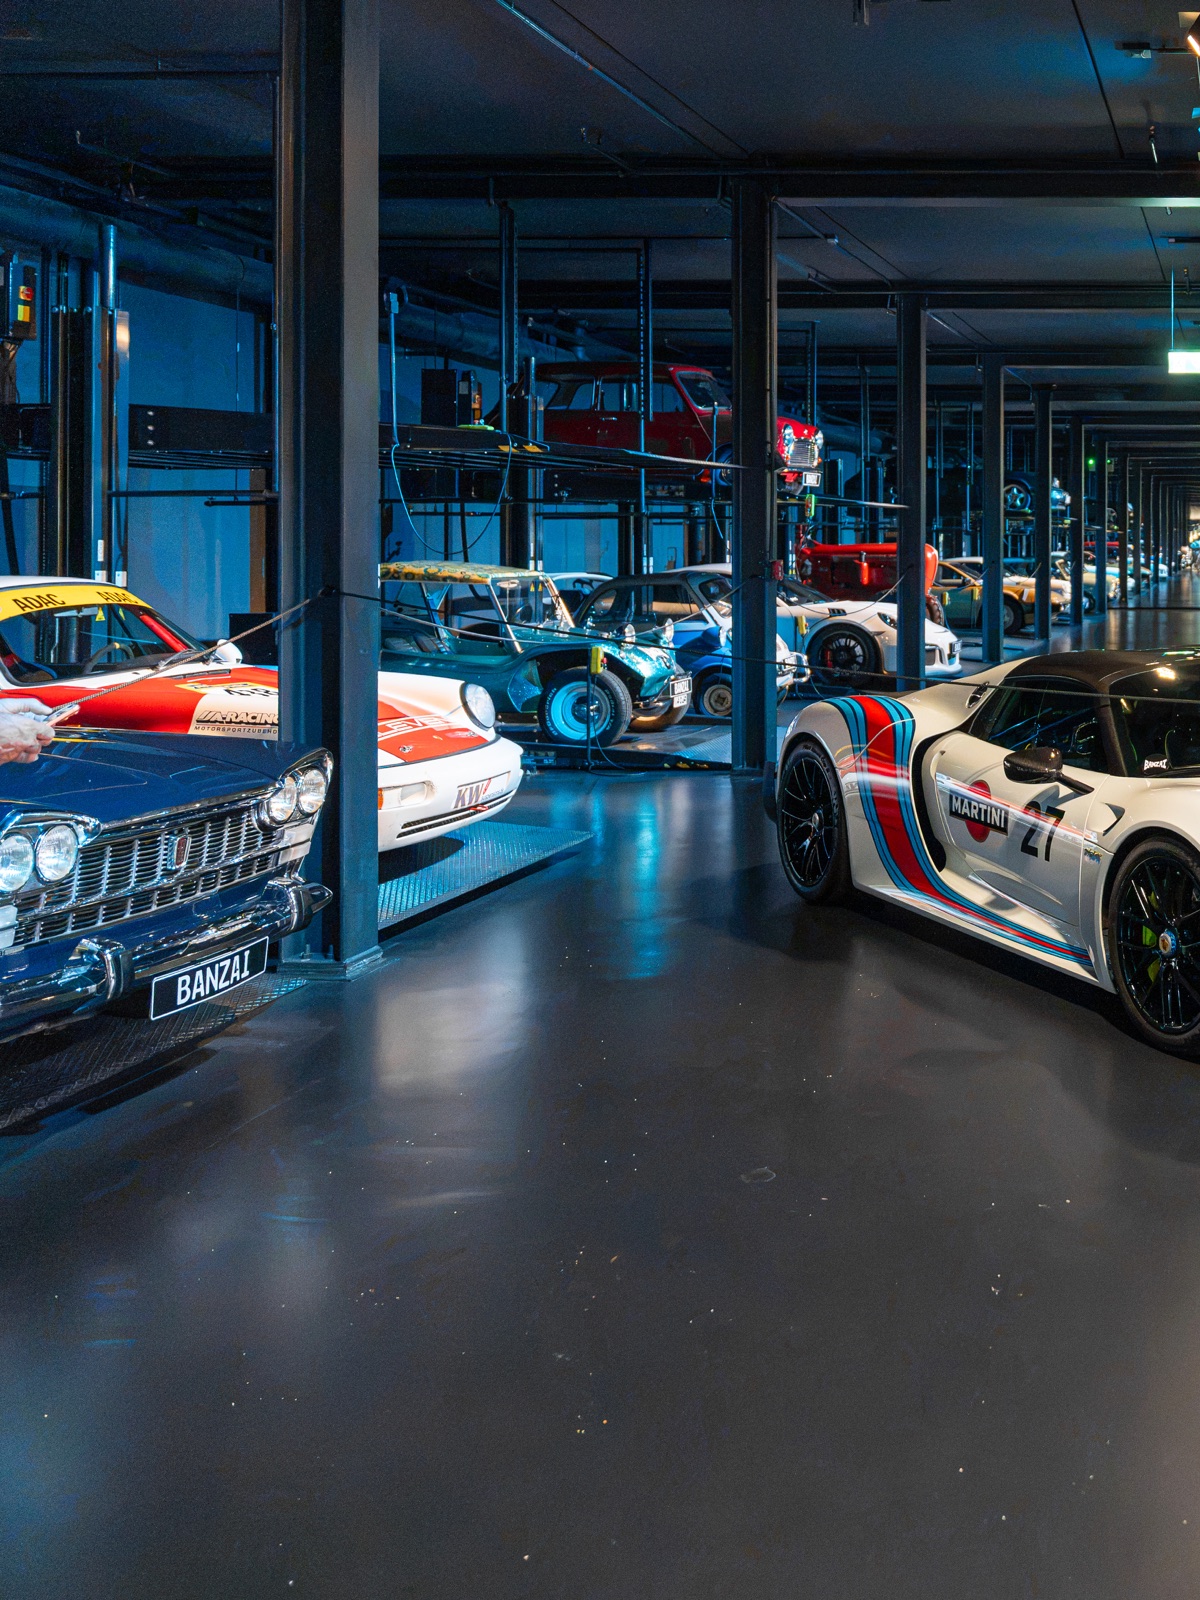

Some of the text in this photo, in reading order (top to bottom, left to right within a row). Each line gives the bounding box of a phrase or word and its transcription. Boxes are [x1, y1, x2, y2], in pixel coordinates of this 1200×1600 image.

[12, 593, 66, 612] ADAC
[96, 591, 138, 604] ADAC
[1143, 758, 1168, 771] BANZAI
[453, 783, 484, 809] KW
[951, 795, 1005, 829] MARTINI
[1020, 800, 1066, 862] 27
[176, 949, 250, 1006] BANZAI
